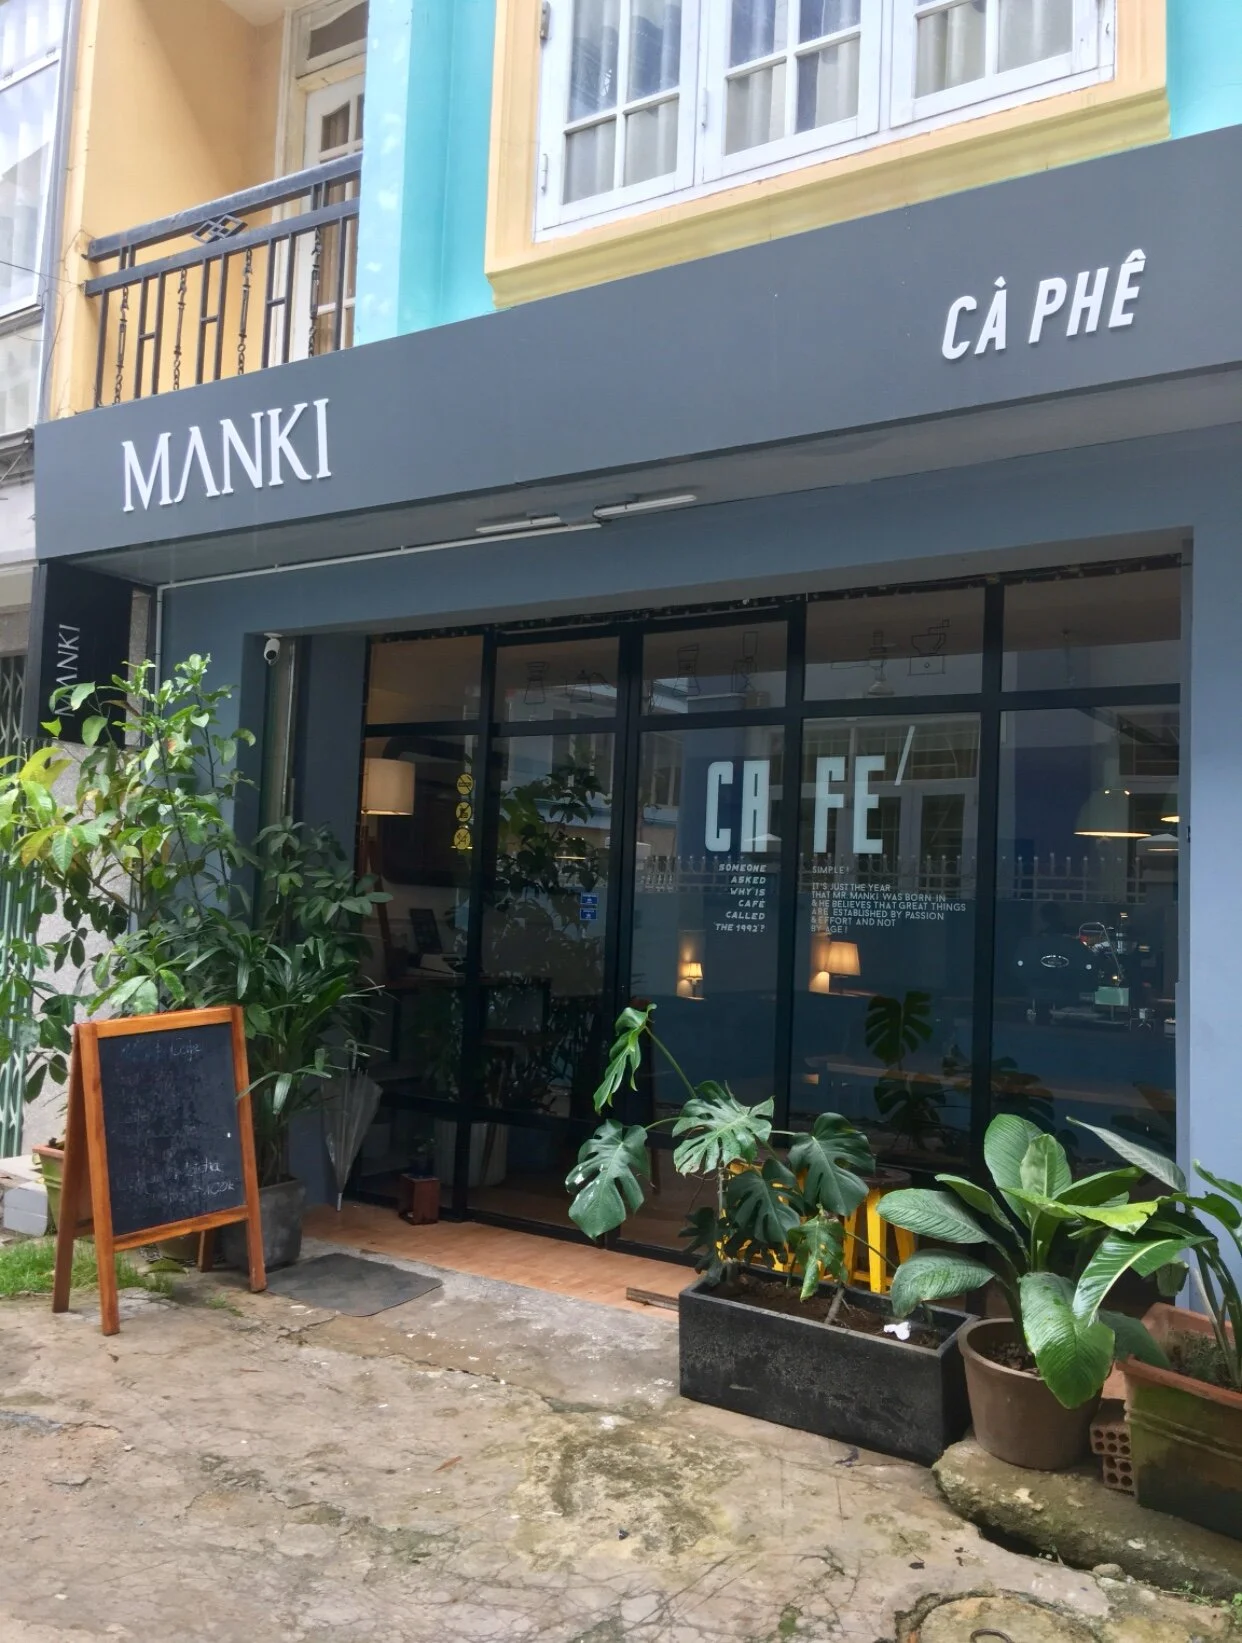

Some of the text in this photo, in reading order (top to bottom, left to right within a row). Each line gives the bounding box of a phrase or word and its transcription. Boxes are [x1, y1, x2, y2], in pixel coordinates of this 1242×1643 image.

[1028, 248, 1147, 344] PHÊ
[121, 398, 332, 512] MANKI
[718, 863, 767, 873] SOMEONE
[730, 875, 767, 885] ASKED
[730, 887, 766, 897] WHY IS
[829, 882, 848, 891] JUST
[851, 883, 866, 892] THE
[868, 883, 891, 892] YEAR
[811, 890, 831, 899] THAT
[849, 892, 879, 901] MANKI
[882, 892, 903, 901] WAS
[904, 893, 932, 902] BORN
[935, 894, 946, 903] IN
[818, 899, 830, 908] HE
[831, 900, 872, 909] BELIEVES
[873, 901, 898, 910] THAT
[898, 901, 928, 911] GREAT
[930, 902, 967, 912] THINGS
[725, 911, 766, 920] CALLED
[811, 907, 945, 921] ARE ESTABLISHED BY PASSION
[818, 915, 852, 925] EFFORT
[855, 917, 875, 926] AND
[876, 918, 896, 927] NOT
